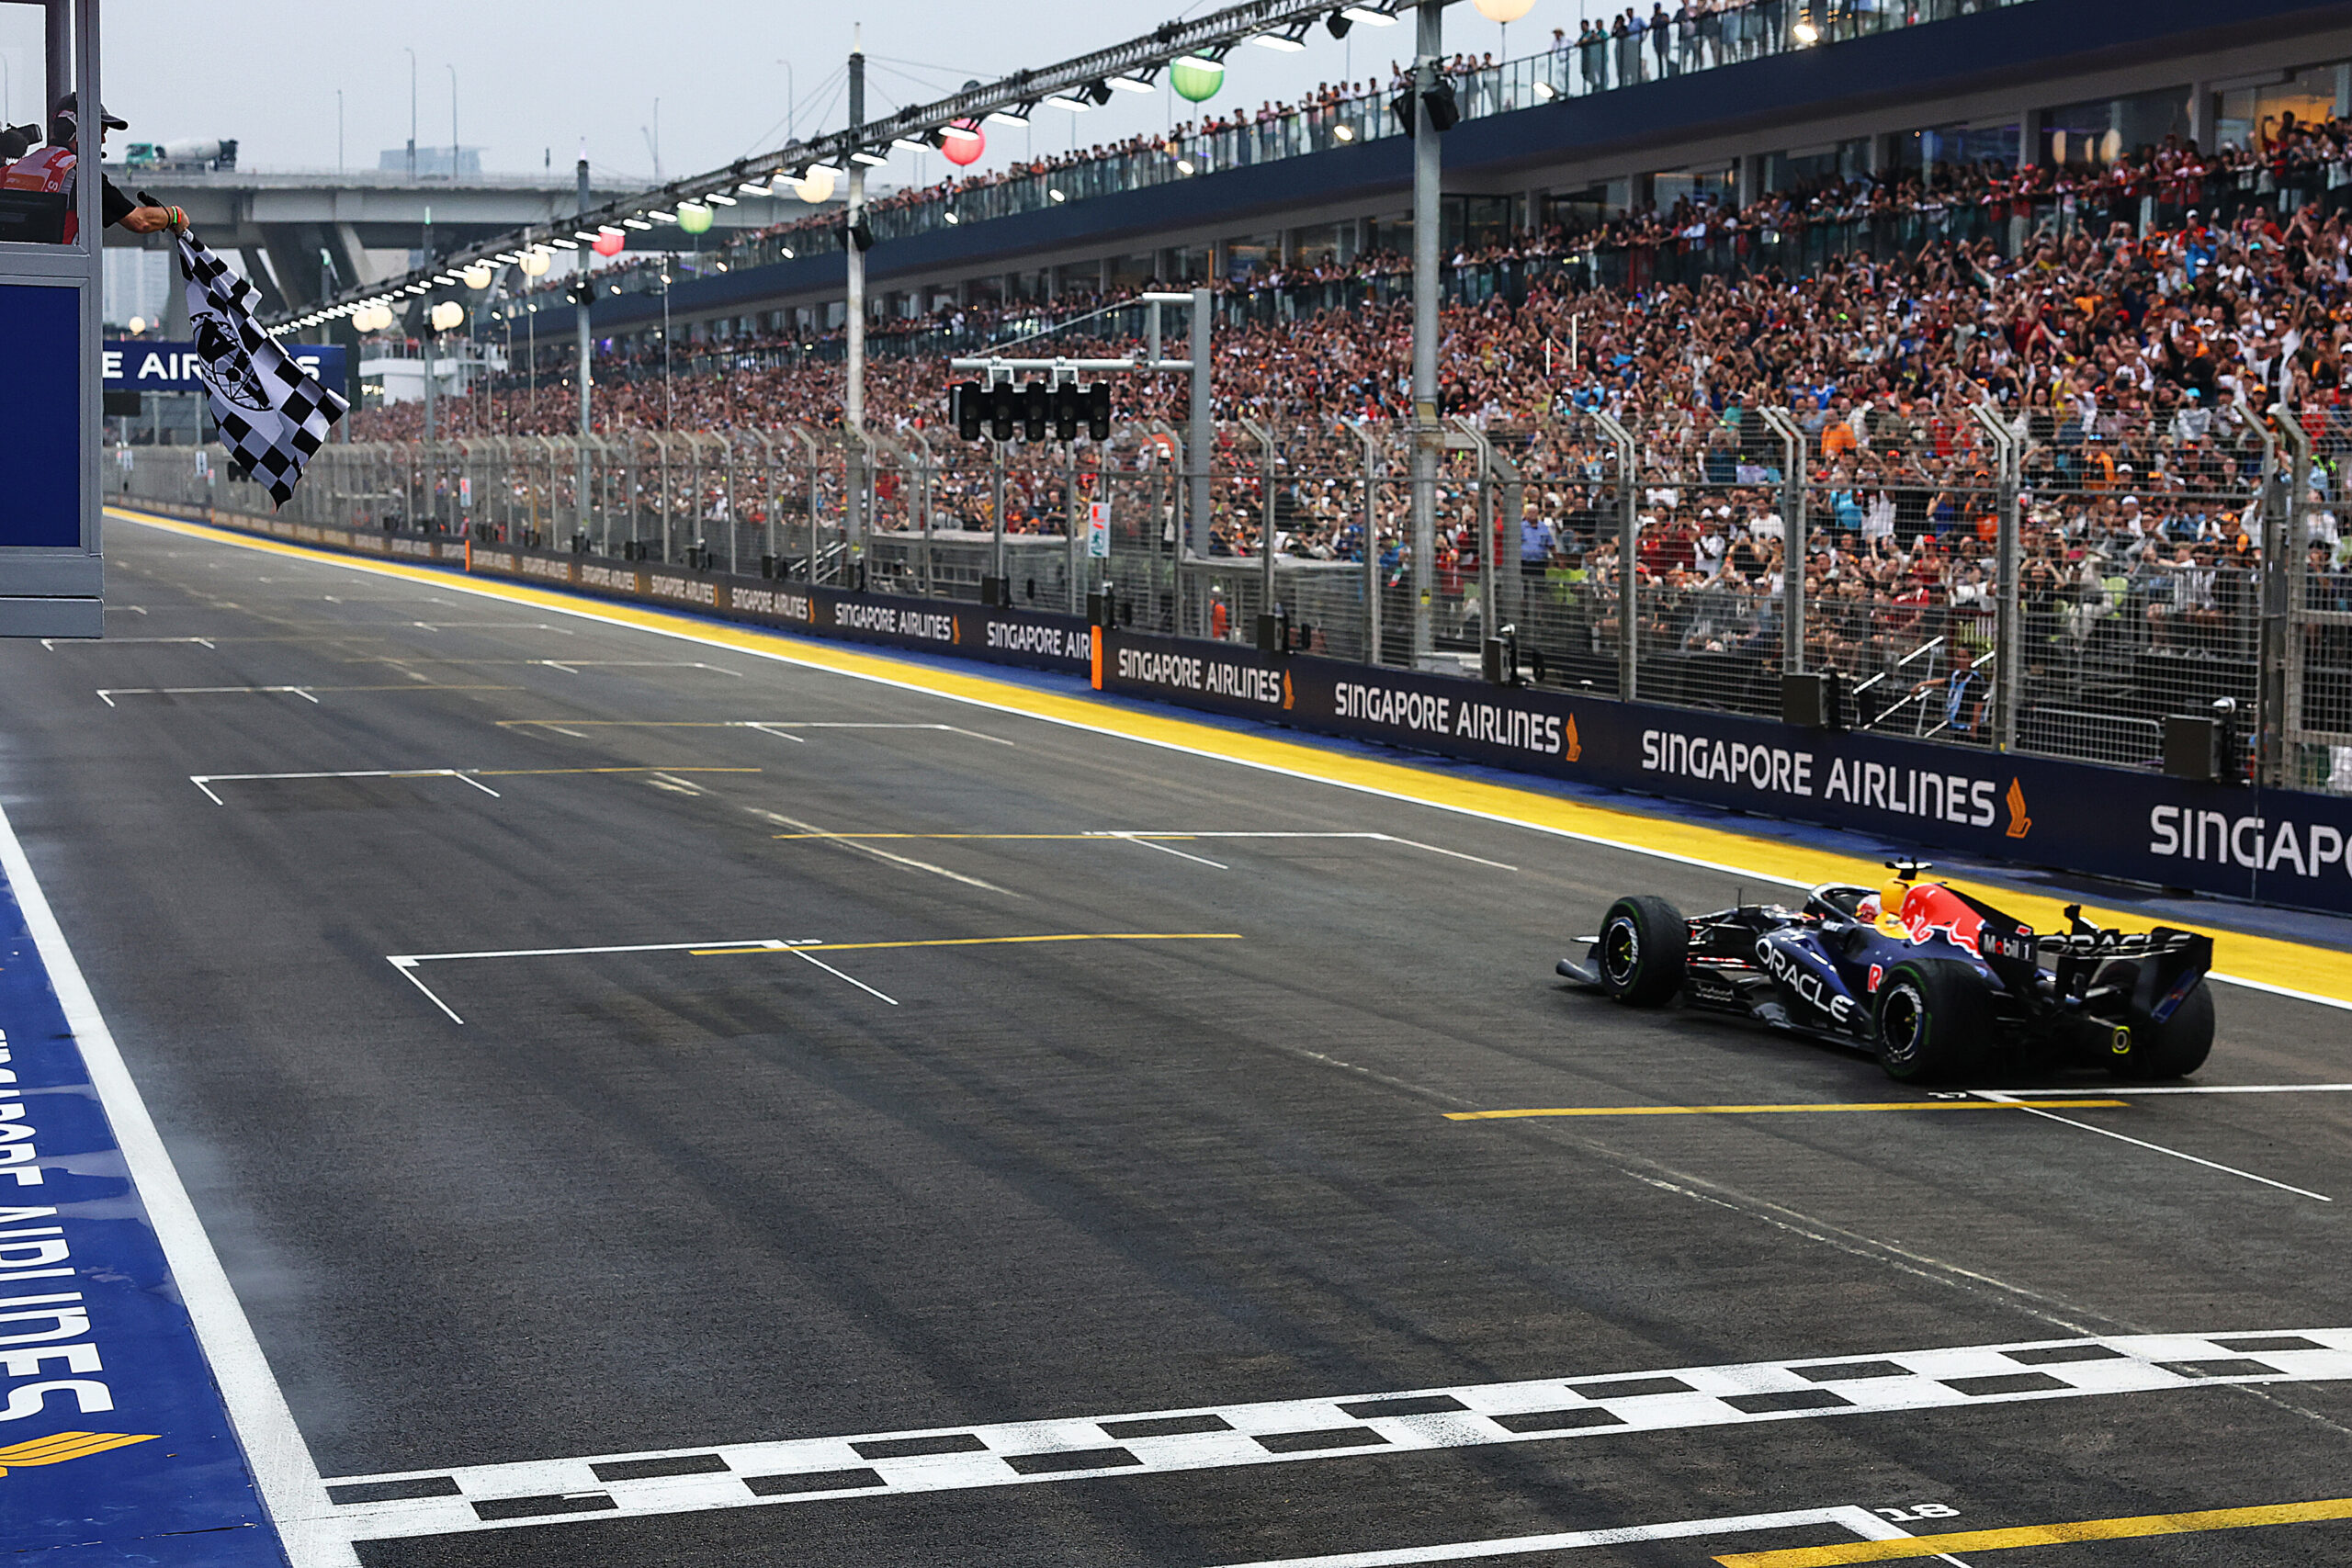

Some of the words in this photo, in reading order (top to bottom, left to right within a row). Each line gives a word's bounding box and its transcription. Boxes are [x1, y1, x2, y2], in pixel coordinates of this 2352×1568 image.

[835, 603, 896, 633] SINGAPORE
[898, 611, 951, 641] AIRLINES
[987, 621, 1062, 656] SINGAPORE
[1118, 648, 1202, 690] SINGAPORE
[1205, 661, 1281, 704] AIRLINES
[1335, 682, 1450, 734] SINGAPORE
[1455, 701, 1561, 754] AIRLINES
[1642, 729, 1813, 796] SINGAPORE
[1825, 757, 1996, 827] AIRLINES
[2150, 805, 2352, 878] SINGAP
[1984, 933, 2019, 959] Mobil
[2024, 943, 2030, 962] 1
[1756, 937, 1856, 1023] ORACLE
[1874, 1503, 1961, 1522] 18
